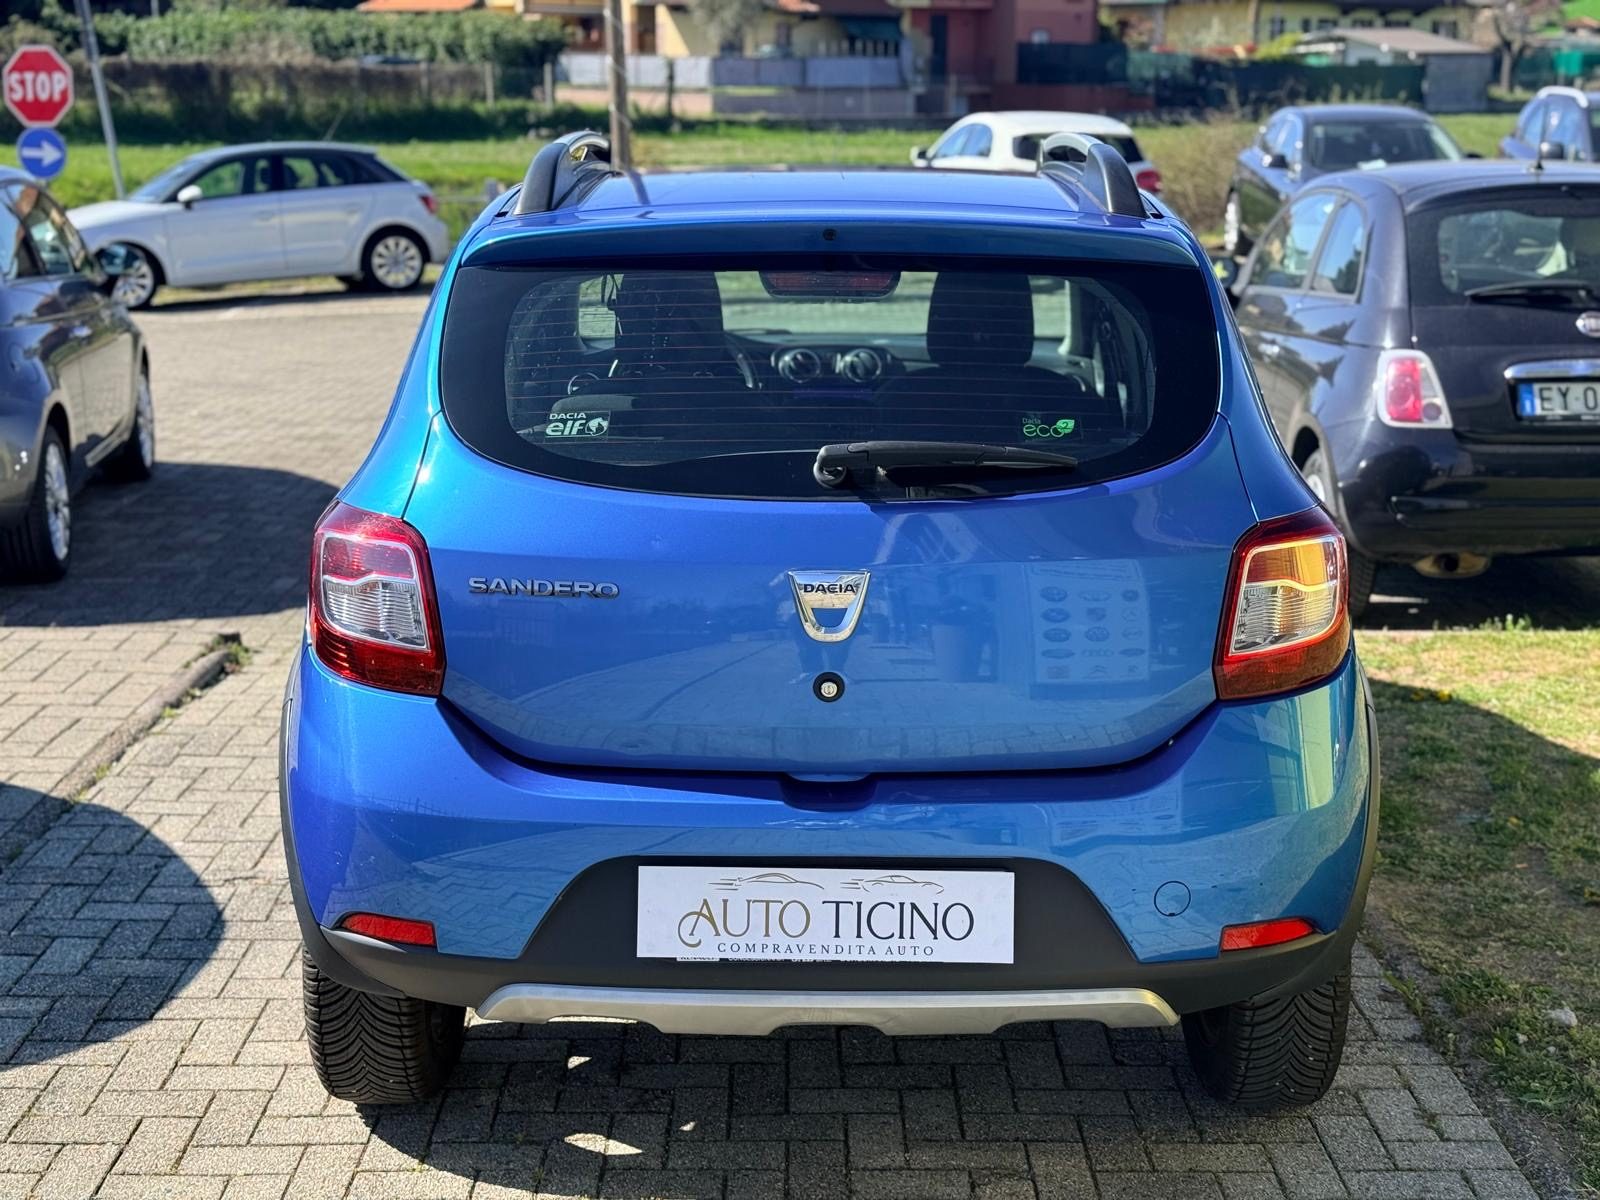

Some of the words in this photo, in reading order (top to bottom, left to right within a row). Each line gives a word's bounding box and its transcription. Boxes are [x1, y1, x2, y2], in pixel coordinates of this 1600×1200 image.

[8, 71, 67, 102] STOP
[1539, 386, 1570, 411] EY
[549, 412, 586, 420] DACIA
[545, 420, 586, 436] elf
[468, 577, 620, 599] SANDERO
[803, 583, 856, 594] DACIA
[677, 898, 811, 948] AUTO
[821, 900, 975, 941] TICINO
[717, 942, 876, 955] COMPRAVENDITA
[885, 945, 934, 956] AUTO
